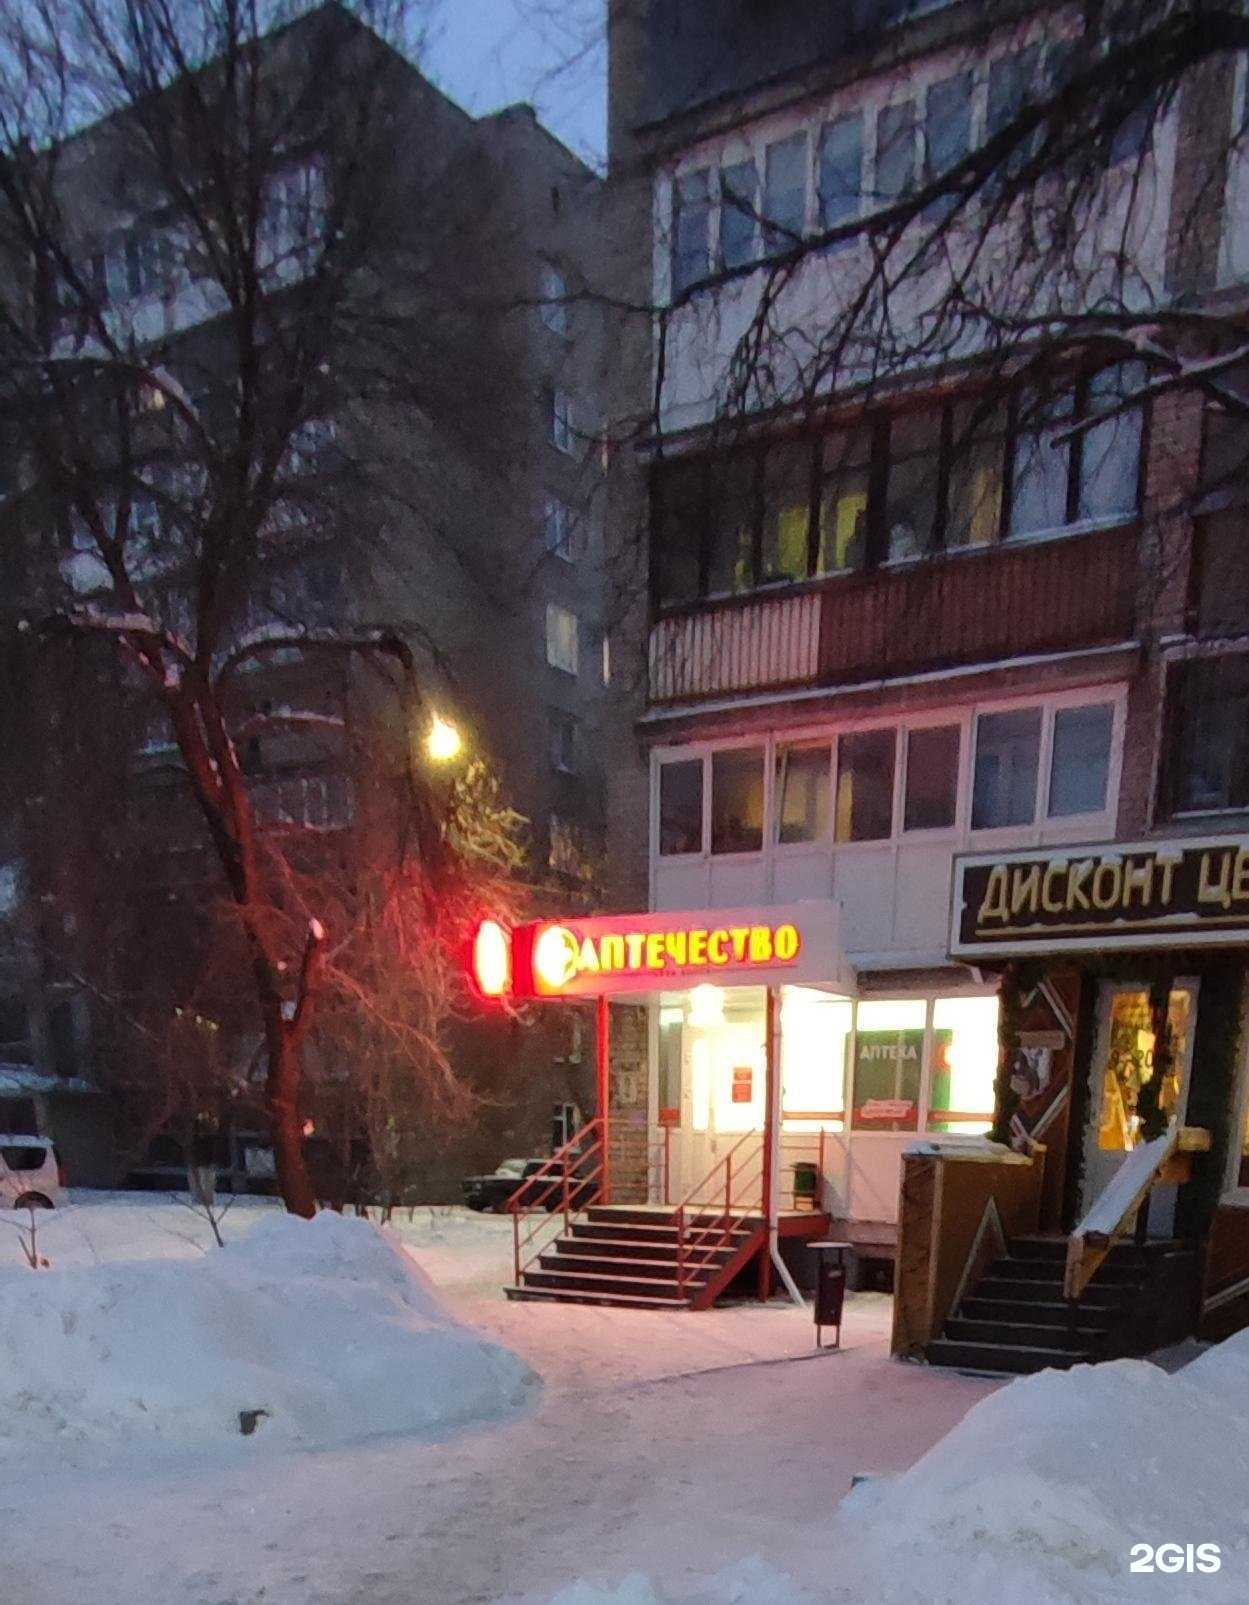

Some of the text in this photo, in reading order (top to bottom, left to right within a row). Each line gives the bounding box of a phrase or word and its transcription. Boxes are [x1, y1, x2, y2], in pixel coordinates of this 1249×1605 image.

[977, 850, 1184, 926] ДИСКОНТ
[575, 924, 800, 971] АПТЕЧЕСТВО
[860, 1044, 918, 1060] АПТЕКА
